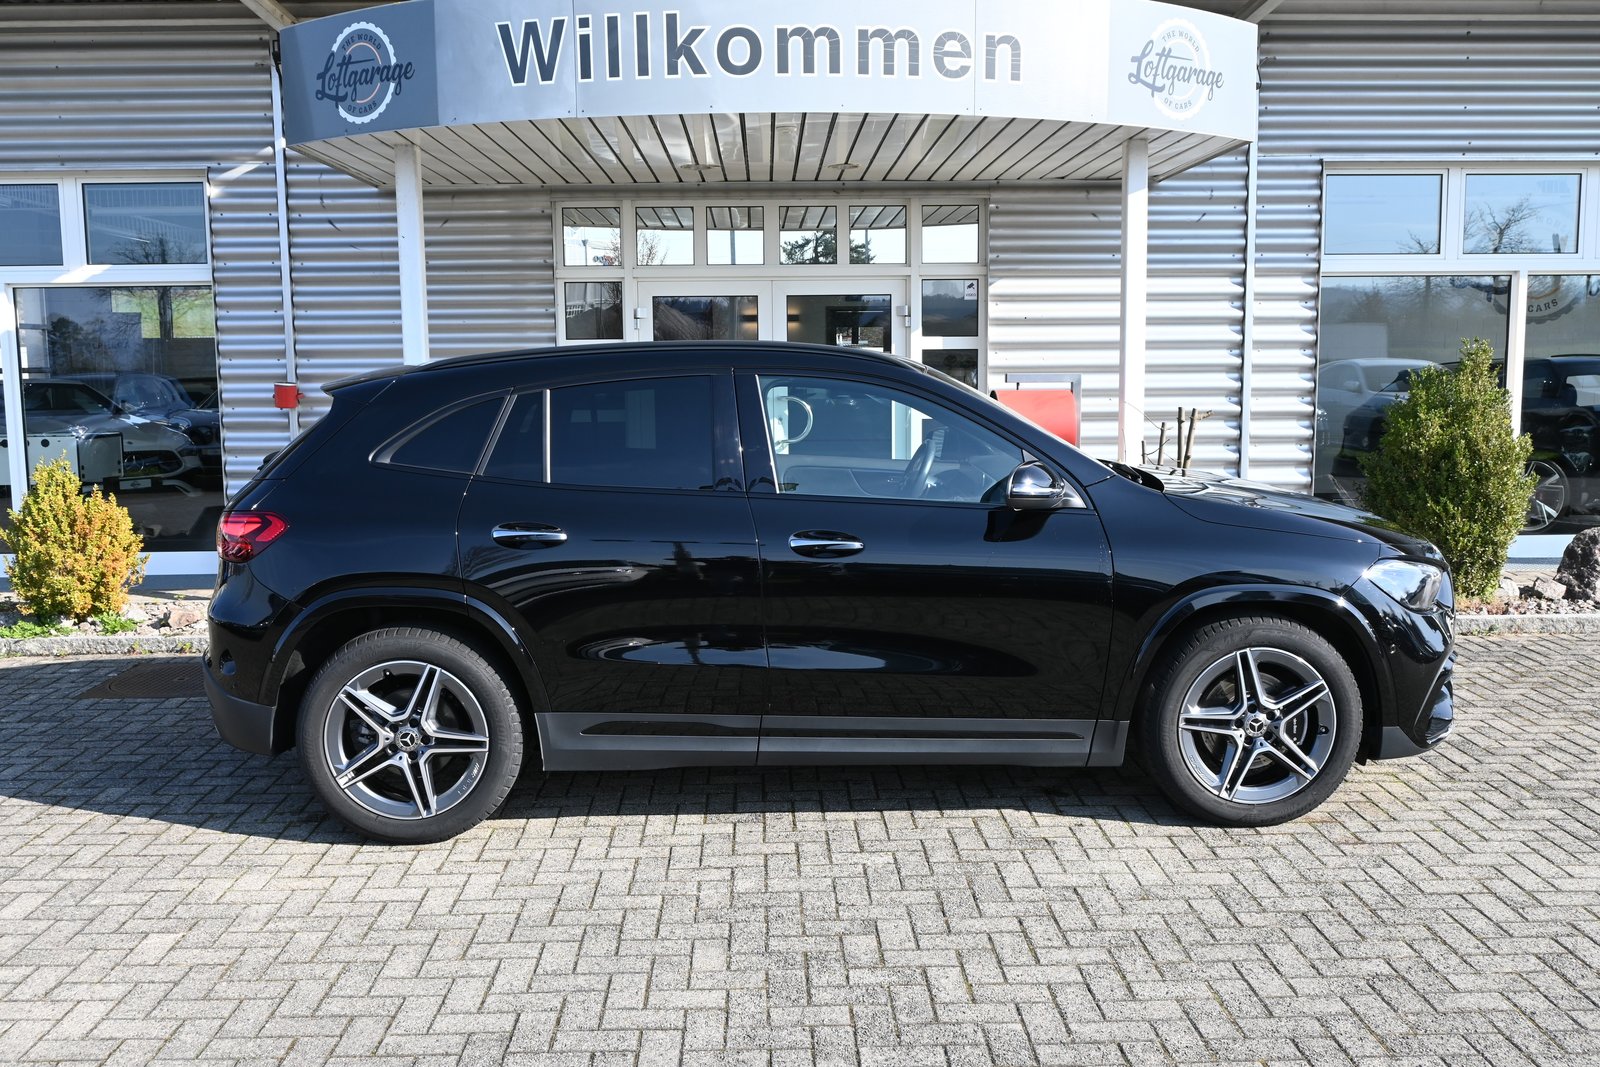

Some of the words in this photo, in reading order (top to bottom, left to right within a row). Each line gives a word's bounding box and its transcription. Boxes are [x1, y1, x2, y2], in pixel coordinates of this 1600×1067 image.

[342, 35, 355, 51] THE
[357, 33, 382, 50] WORLD
[495, 10, 1023, 87] Willkommen
[1161, 30, 1176, 42] THE
[1178, 30, 1200, 53] WORLD
[315, 50, 415, 109] Loftgarage
[1128, 39, 1225, 101] Loftgarage
[347, 104, 357, 114] OF
[358, 100, 377, 114] CARS
[1163, 97, 1173, 108] OF
[1174, 100, 1193, 110] CARS
[1527, 298, 1559, 313] CARS
